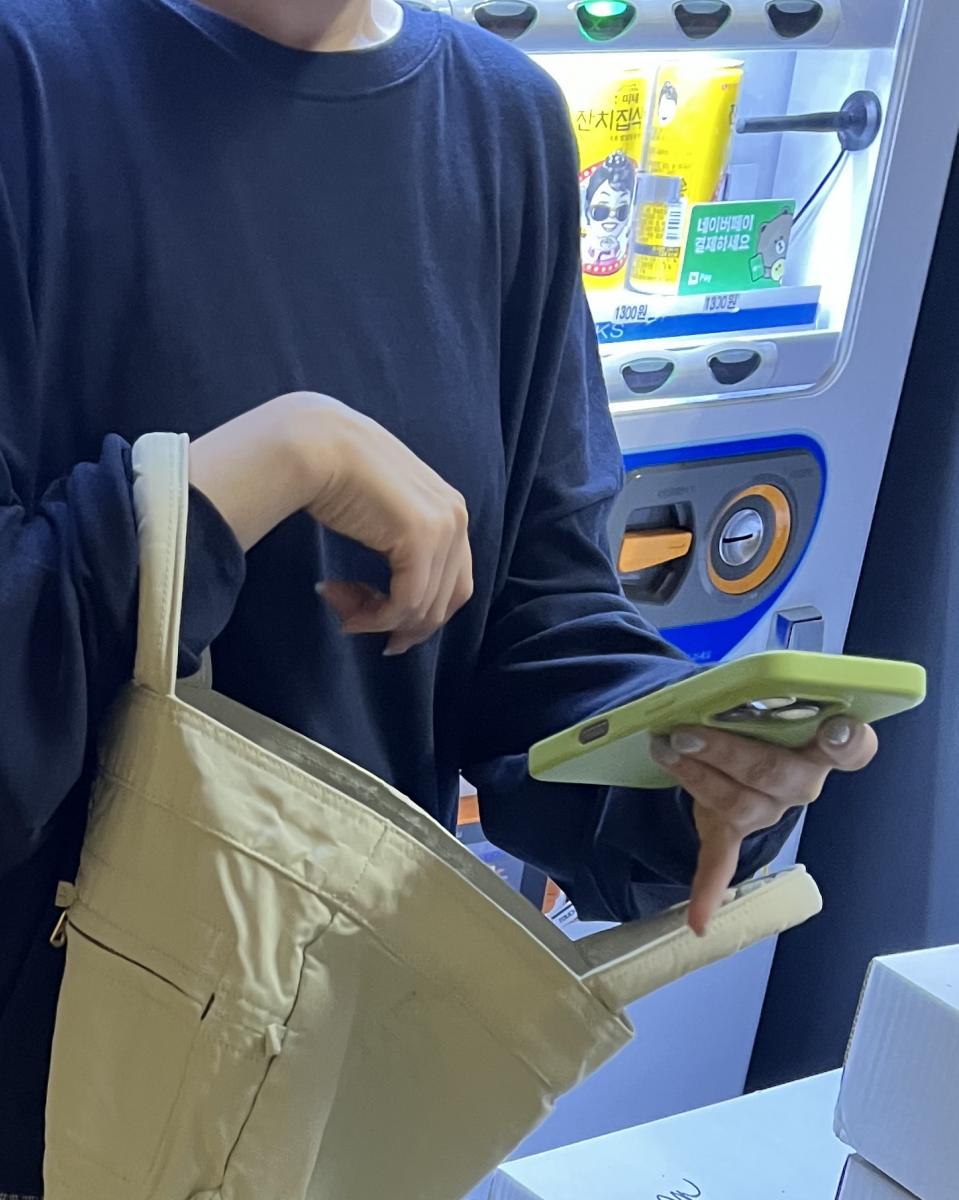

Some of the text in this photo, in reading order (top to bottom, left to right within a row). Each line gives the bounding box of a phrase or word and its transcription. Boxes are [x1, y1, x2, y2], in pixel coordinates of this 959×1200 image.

[696, 214, 755, 233] 네이버페이
[695, 235, 751, 254] 결제하세요
[614, 304, 648, 321] 1300원
